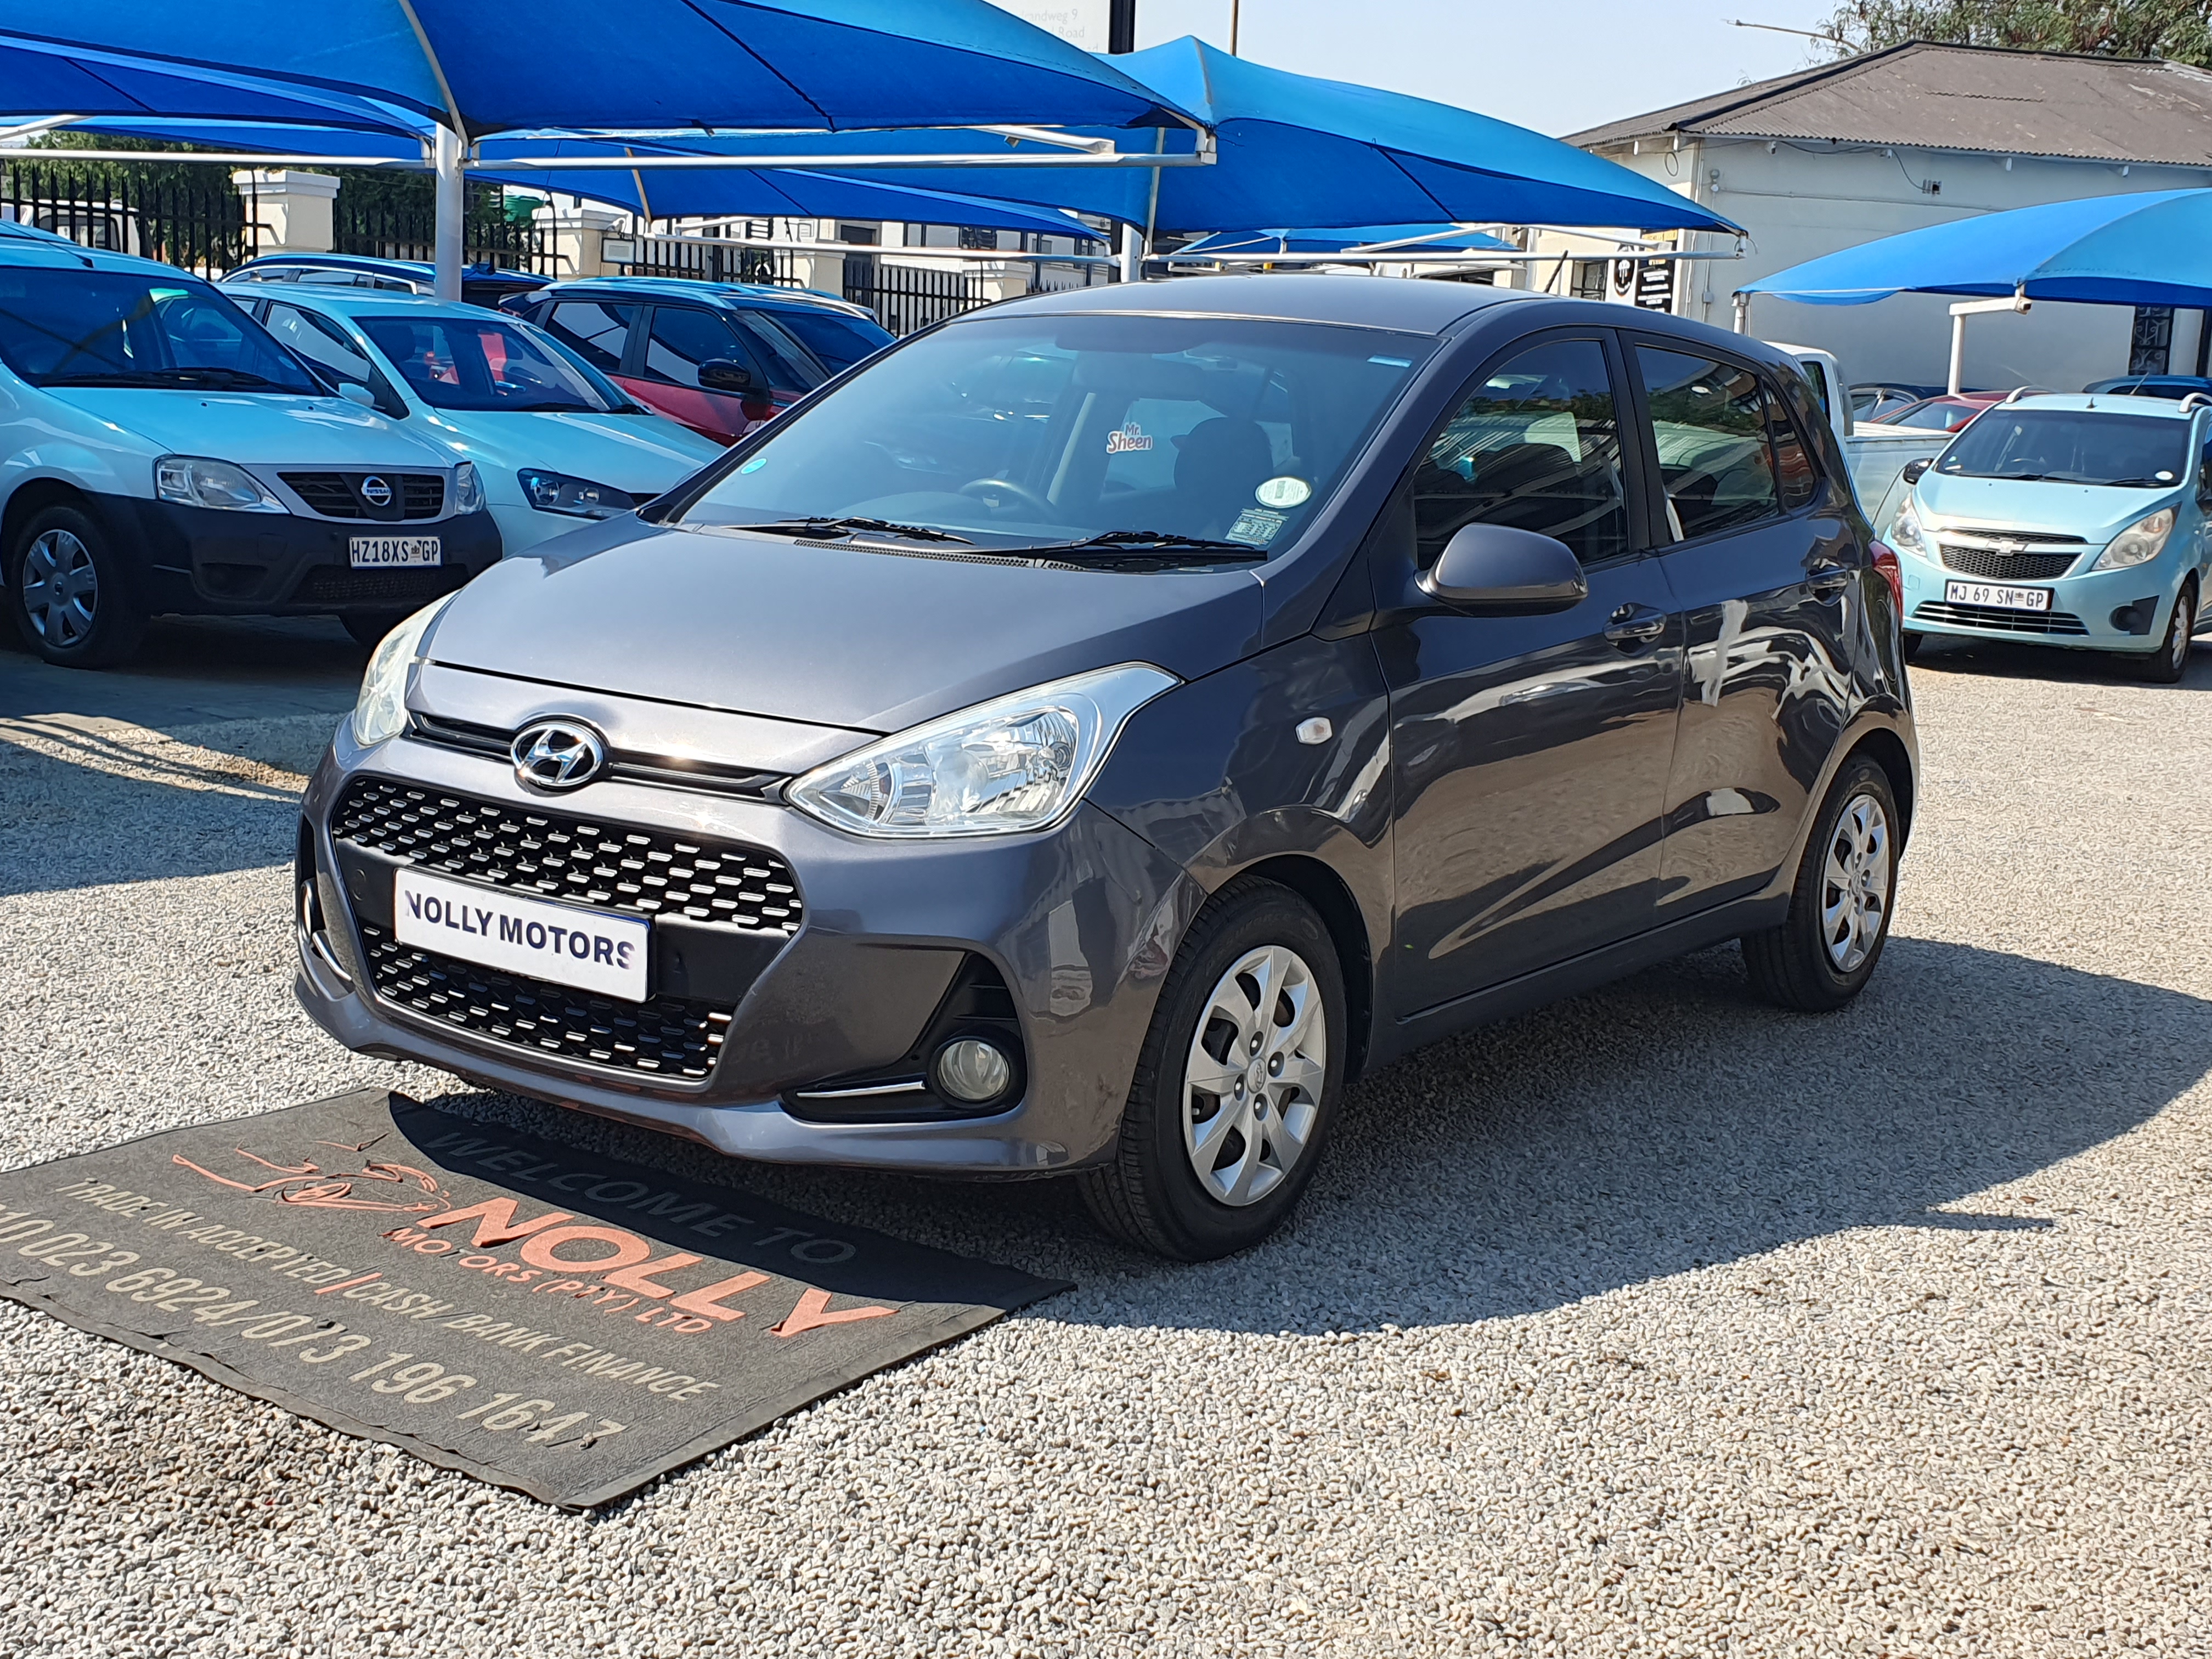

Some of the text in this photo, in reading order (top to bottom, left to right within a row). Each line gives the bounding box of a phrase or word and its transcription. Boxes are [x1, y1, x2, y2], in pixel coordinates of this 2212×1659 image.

[1058, 26, 1085, 38] Road
[1108, 432, 1152, 452] Sheen
[1125, 424, 1140, 436] Mr.
[351, 540, 438, 563] HZ18XS GP
[2026, 592, 2044, 607] GP
[404, 890, 635, 970] NOLLY MOTORS
[424, 1132, 856, 1263] WELCOME TO
[55, 1177, 170, 1218] TRADE
[539, 1342, 723, 1401] FINANCE
[416, 1197, 900, 1337] NOLLY
[18, 1233, 141, 1277] 023
[347, 1351, 478, 1404] 196
[532, 1279, 640, 1313] (PTY)
[634, 1307, 713, 1333] LTD
